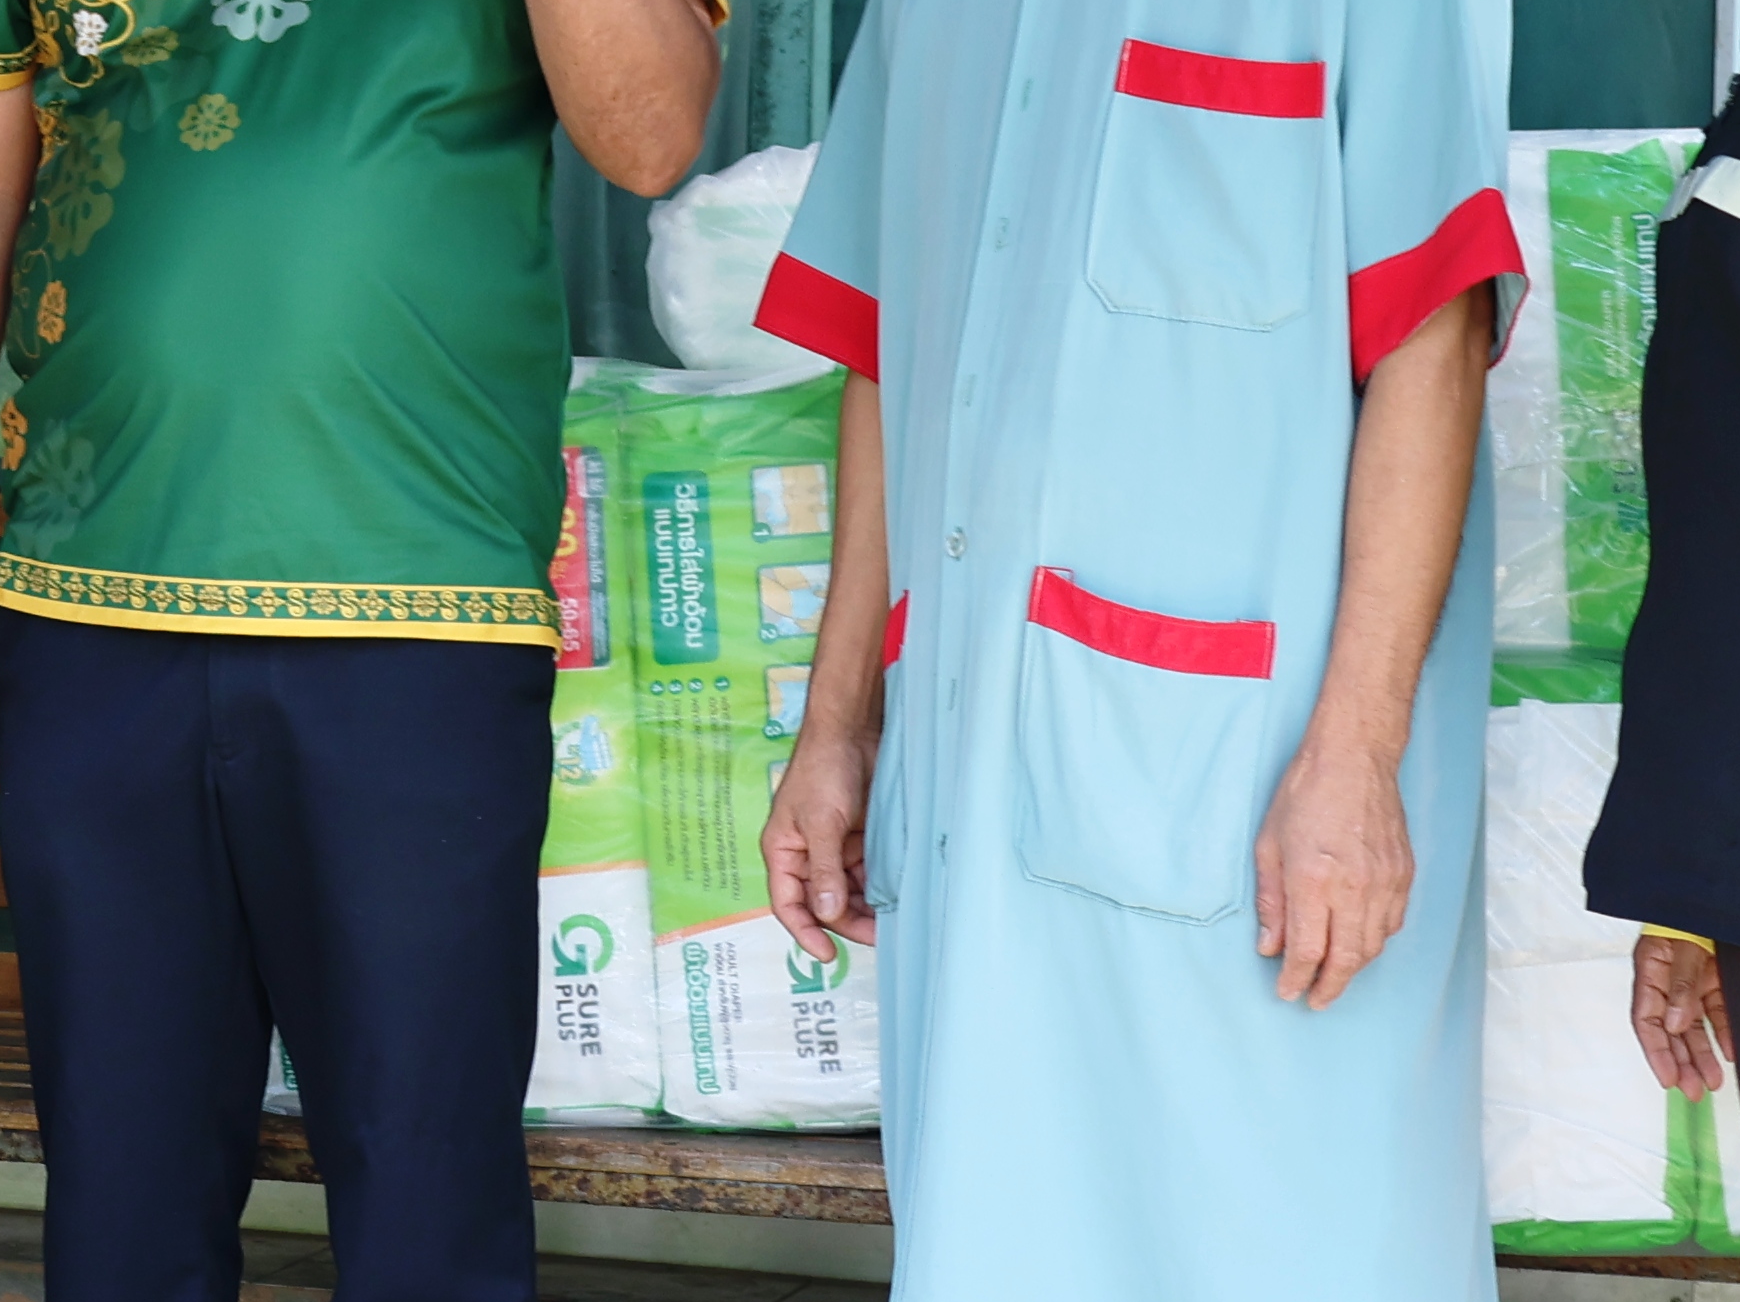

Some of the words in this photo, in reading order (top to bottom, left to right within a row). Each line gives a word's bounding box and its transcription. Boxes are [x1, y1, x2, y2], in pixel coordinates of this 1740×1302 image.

[555, 983, 577, 1042] PLUS
[576, 983, 603, 1057] SURE
[792, 1001, 816, 1060] PLUS
[813, 999, 842, 1075] SURE
